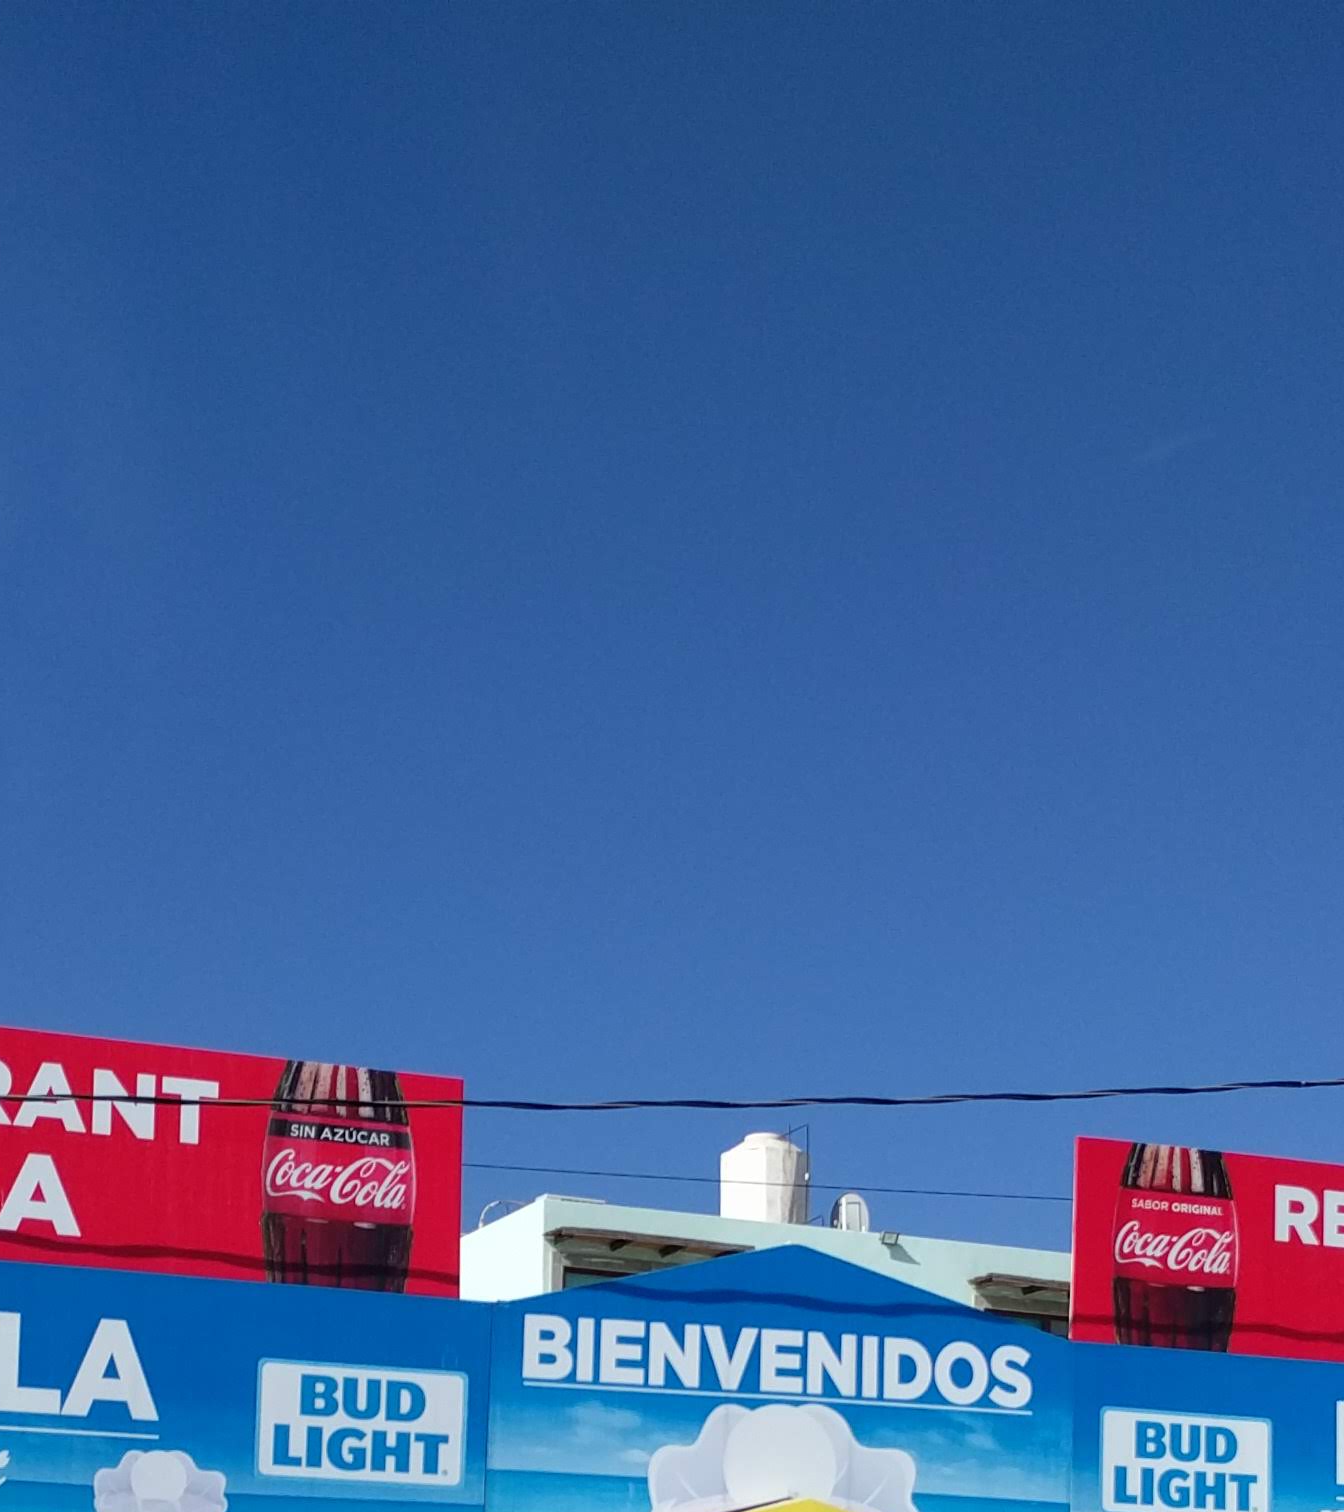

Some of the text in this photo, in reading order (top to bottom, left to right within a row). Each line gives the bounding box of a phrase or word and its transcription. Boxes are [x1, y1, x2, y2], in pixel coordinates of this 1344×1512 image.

[290, 1124, 390, 1146] SIN AZÚCAR
[266, 1149, 409, 1209] Coca-Cola
[1132, 1198, 1224, 1216] SABOR ORIGINAL
[1115, 1220, 1233, 1274] Coca-Cola
[521, 1314, 1034, 1410] BIENVENIDOS
[300, 1373, 426, 1422] BUD
[272, 1423, 449, 1476] LIGHT
[1134, 1420, 1239, 1463] BUD
[1113, 1464, 1258, 1512] LIGHT
